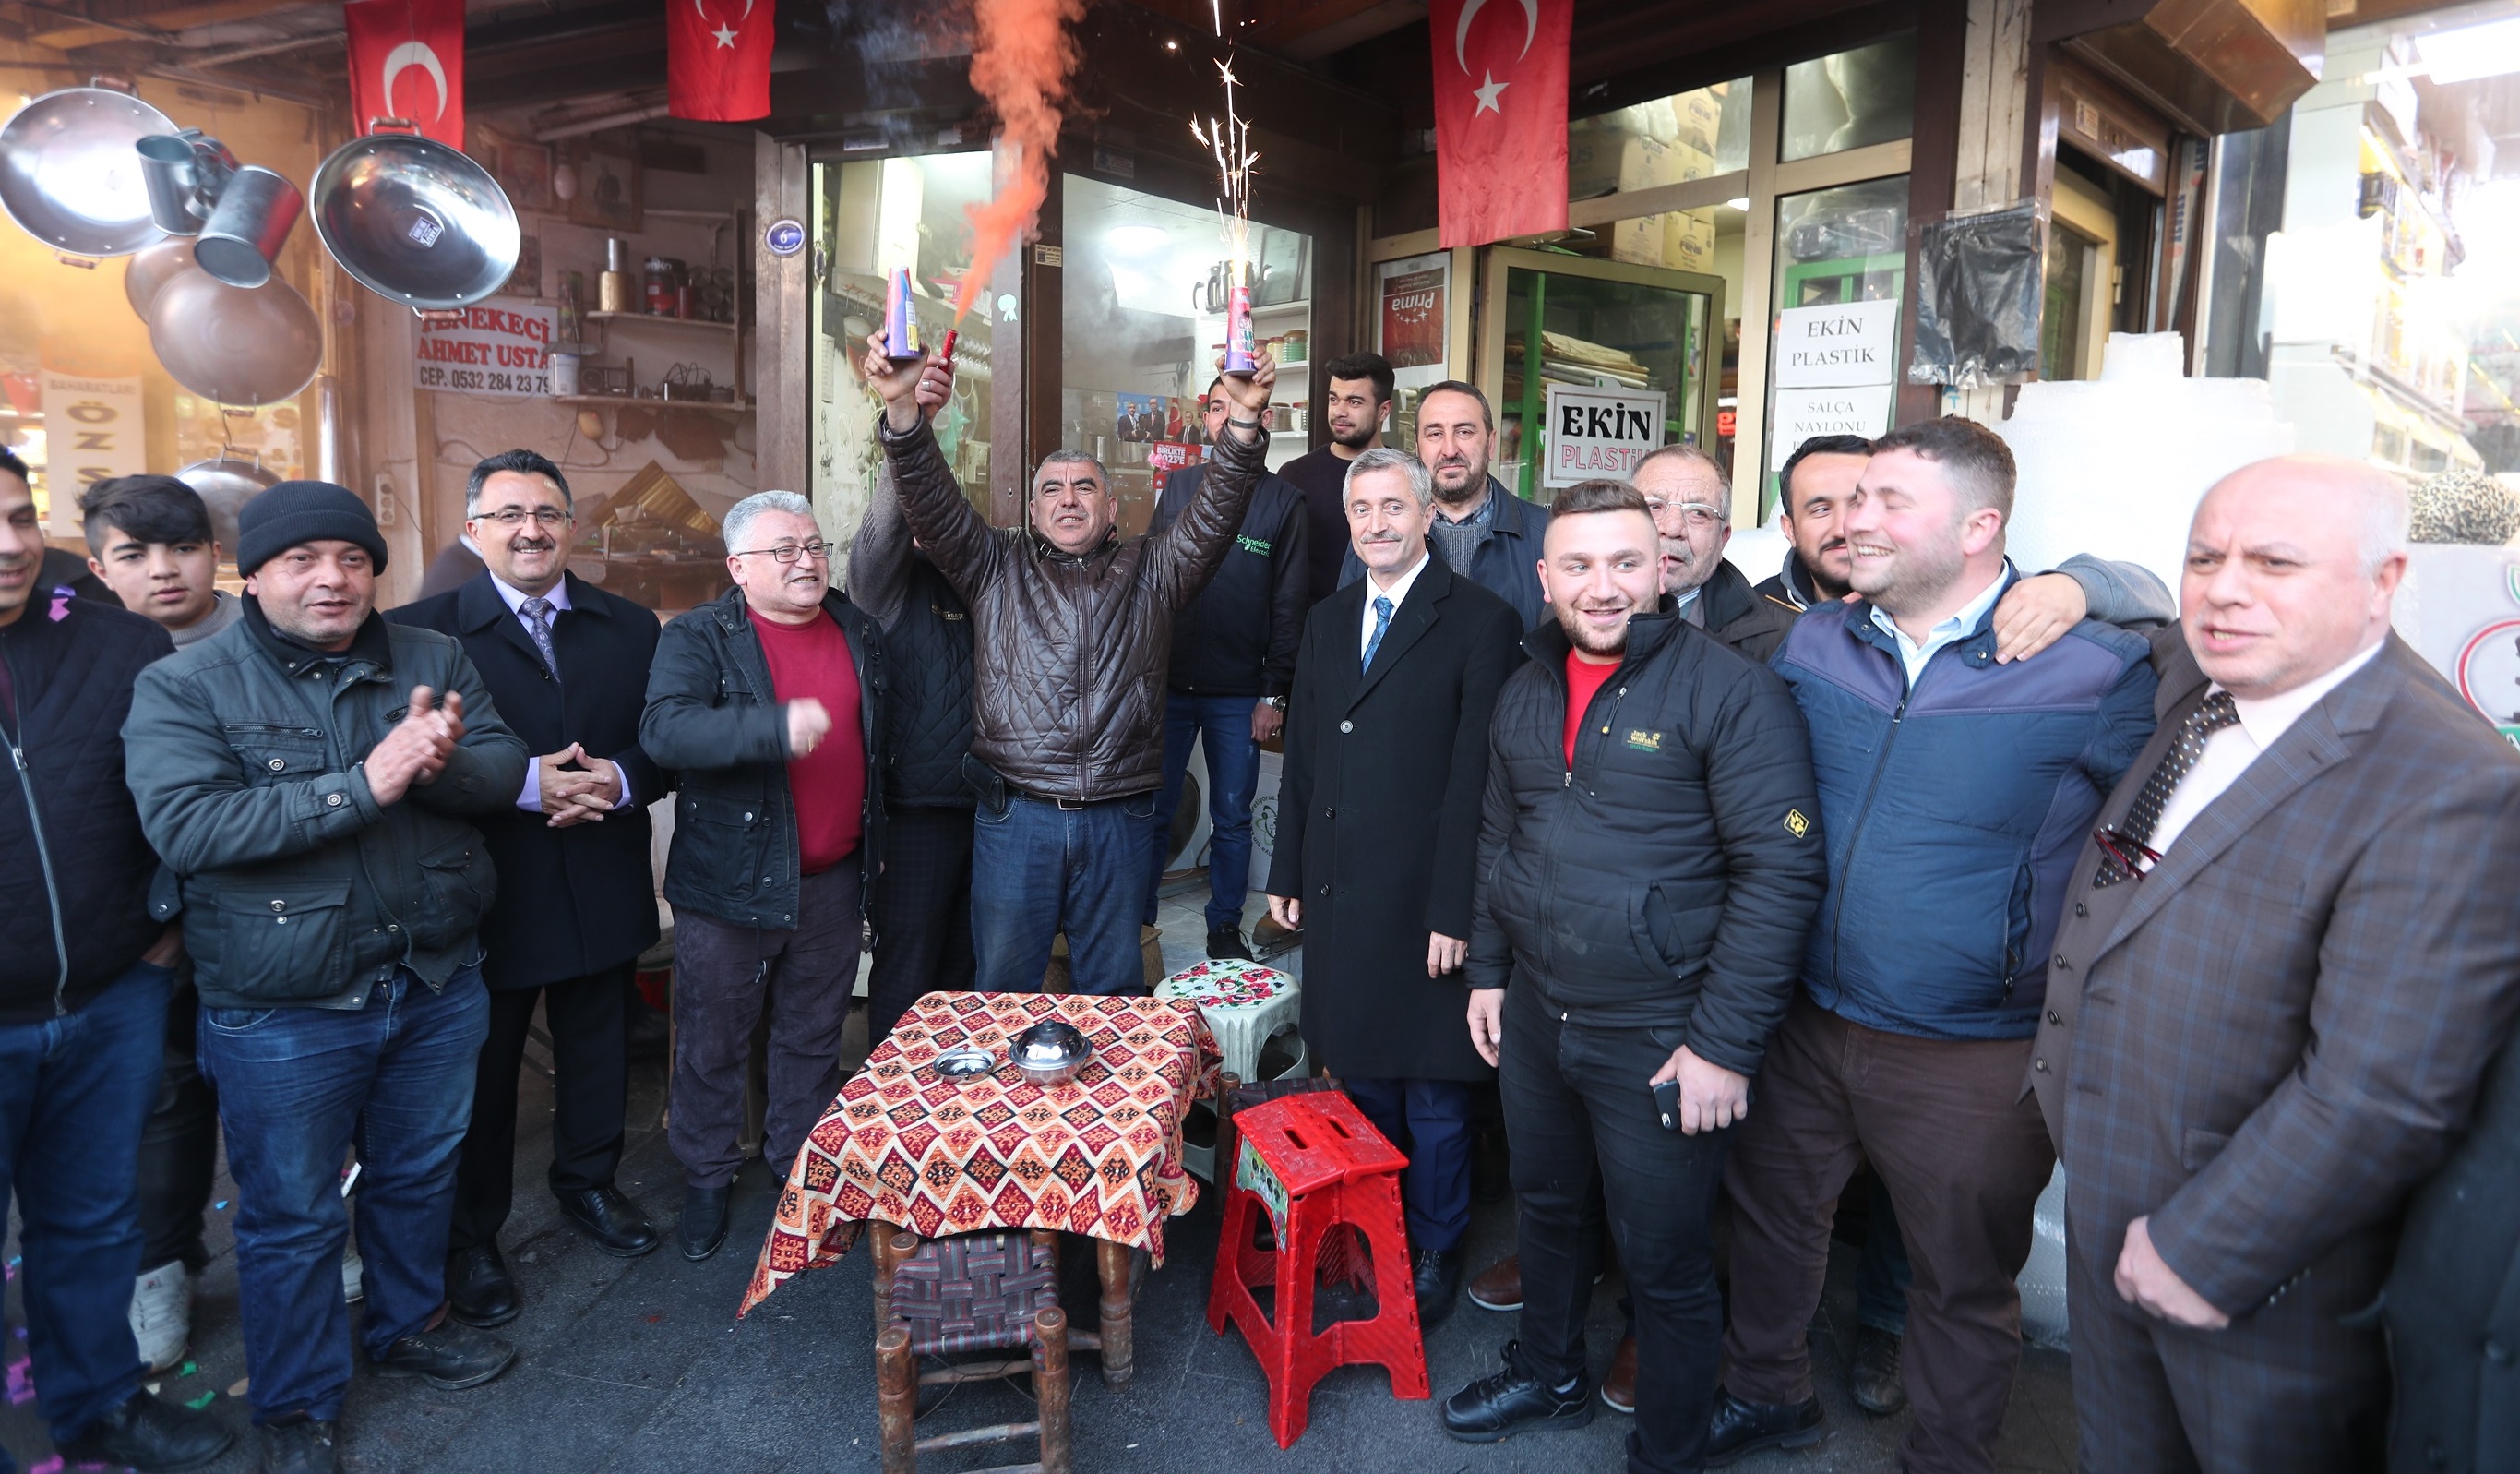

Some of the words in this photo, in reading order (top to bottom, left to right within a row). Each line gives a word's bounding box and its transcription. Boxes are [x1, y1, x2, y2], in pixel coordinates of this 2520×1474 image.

[780, 229, 788, 244] 6
[1391, 292, 1436, 312] Prima
[1808, 316, 1863, 338] EKİN
[417, 337, 492, 366] AHMET
[496, 344, 549, 370] USTA
[1791, 344, 1876, 367] PLASTİK
[420, 366, 448, 388] CEP.
[451, 370, 484, 389] 0532
[488, 373, 513, 391] 284
[517, 375, 532, 392] 23
[1808, 401, 1855, 415] SALÇA
[1562, 402, 1652, 441] EKİN
[1794, 421, 1867, 434] NAYLONU
[1161, 454, 1185, 465] 023'E
[1236, 533, 1272, 550] Schneider
